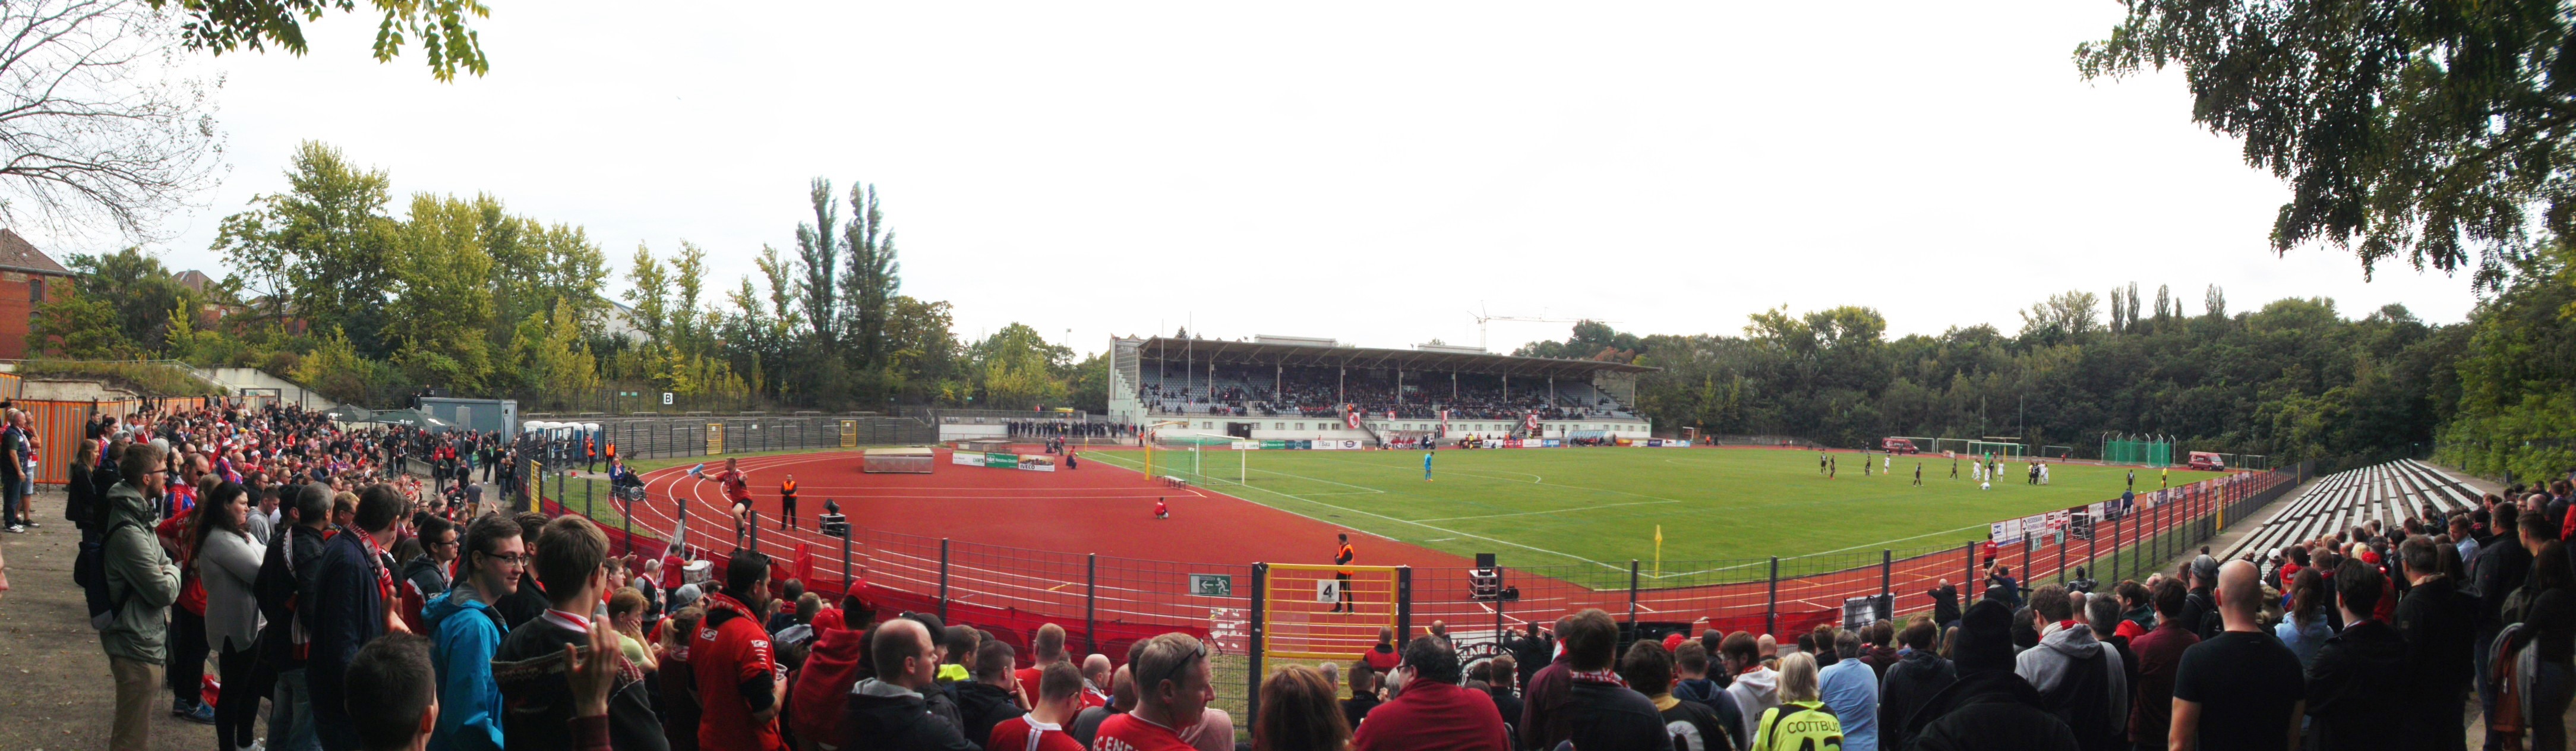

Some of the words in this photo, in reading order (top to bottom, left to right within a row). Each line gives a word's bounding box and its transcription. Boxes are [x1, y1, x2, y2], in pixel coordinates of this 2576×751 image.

[665, 394, 671, 403] B
[1323, 583, 1333, 598] 4
[1787, 721, 1840, 734] COTTBUS
